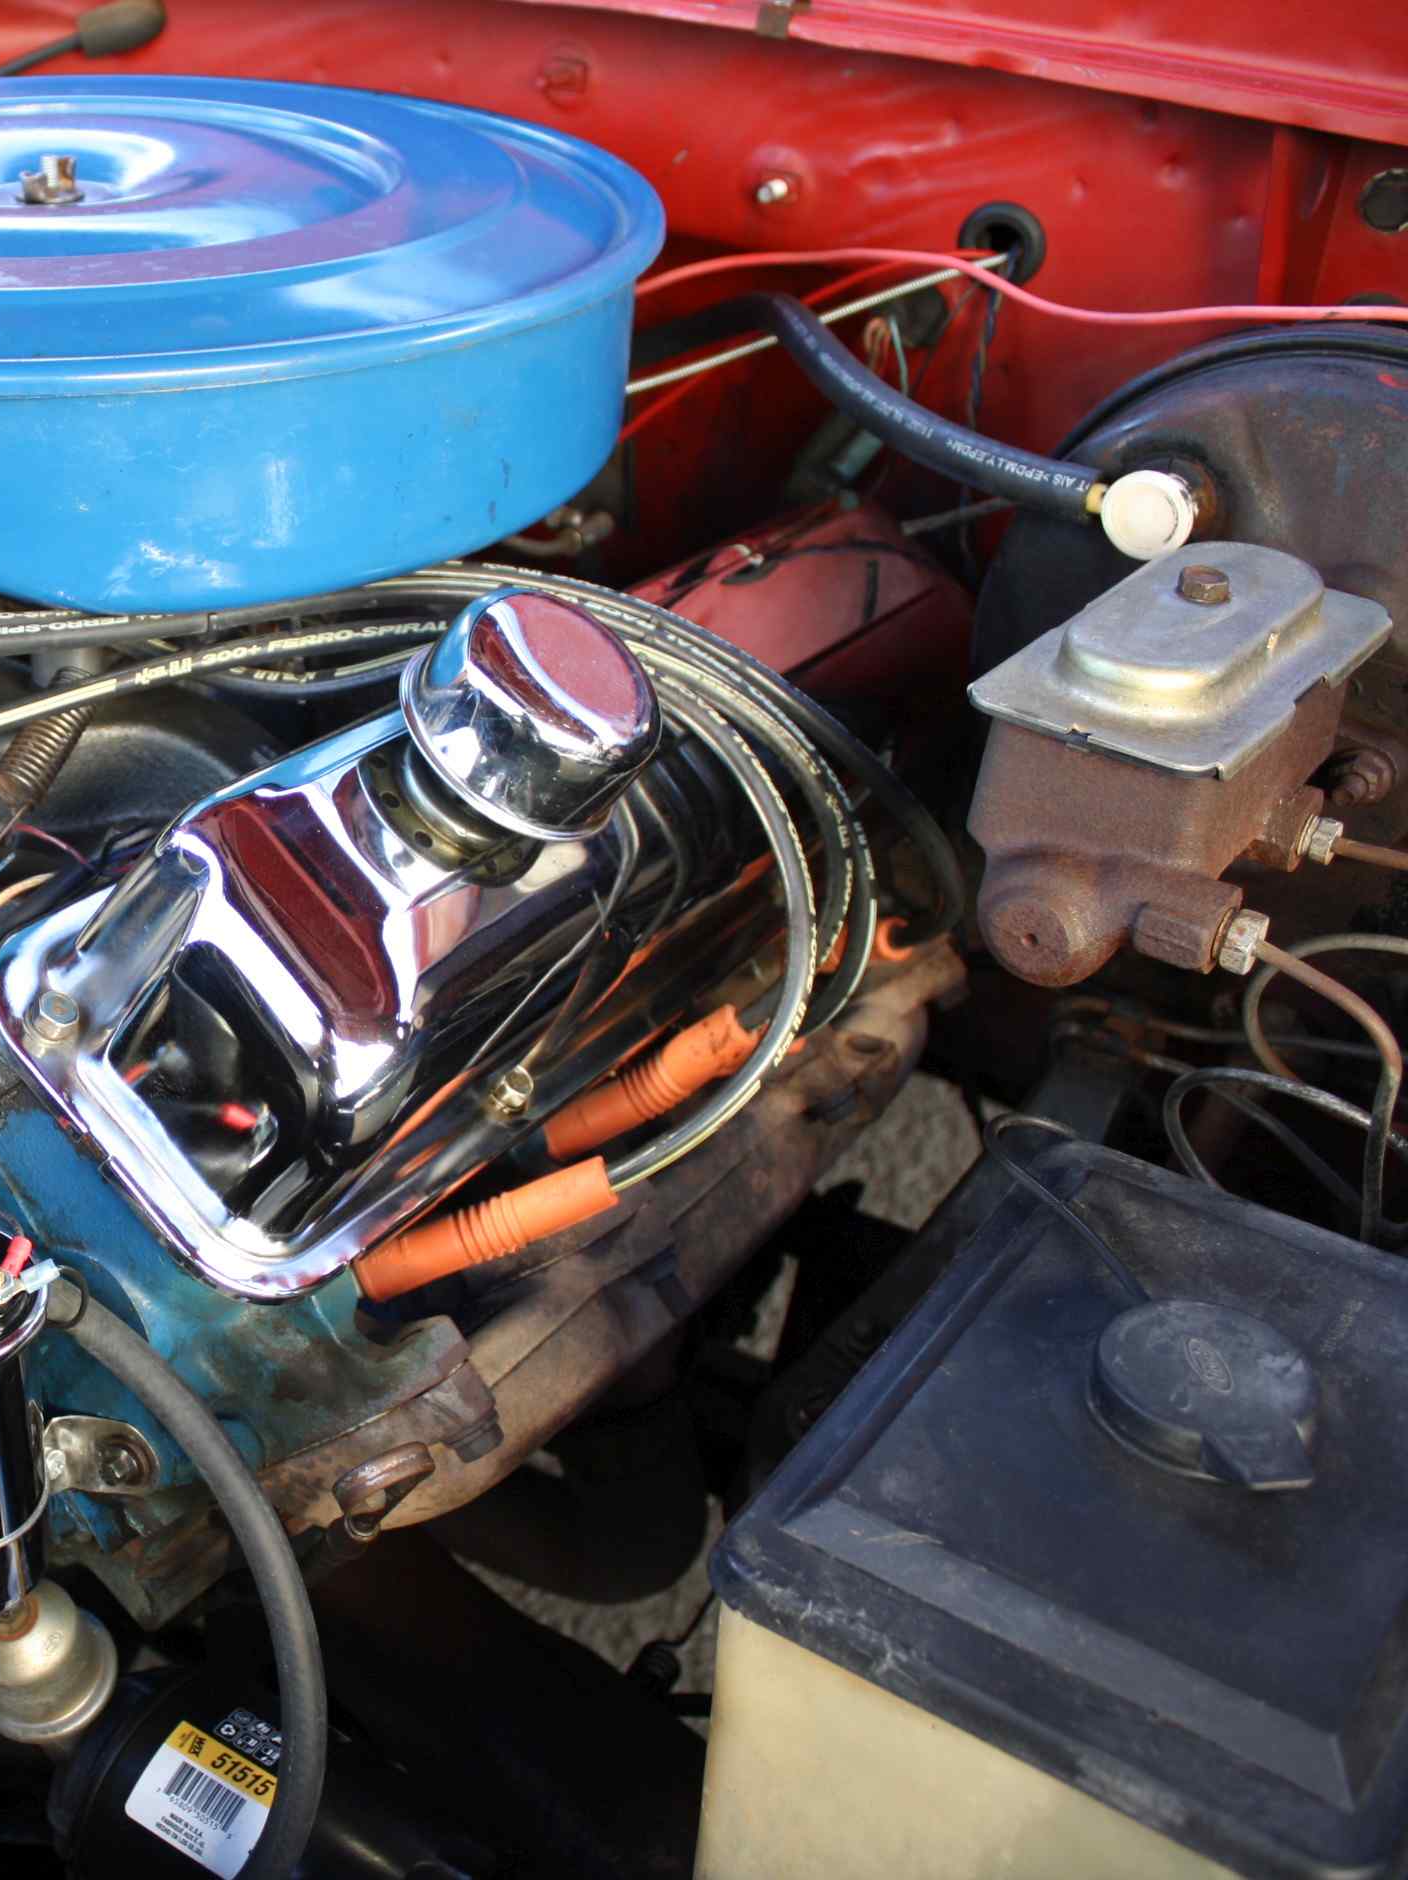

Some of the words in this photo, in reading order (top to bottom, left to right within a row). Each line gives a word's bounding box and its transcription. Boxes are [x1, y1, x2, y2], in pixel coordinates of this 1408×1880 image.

[200, 645, 261, 667] 300+
[267, 620, 449, 653] FERRO-SPIRAL
[211, 1752, 276, 1796] 51515
